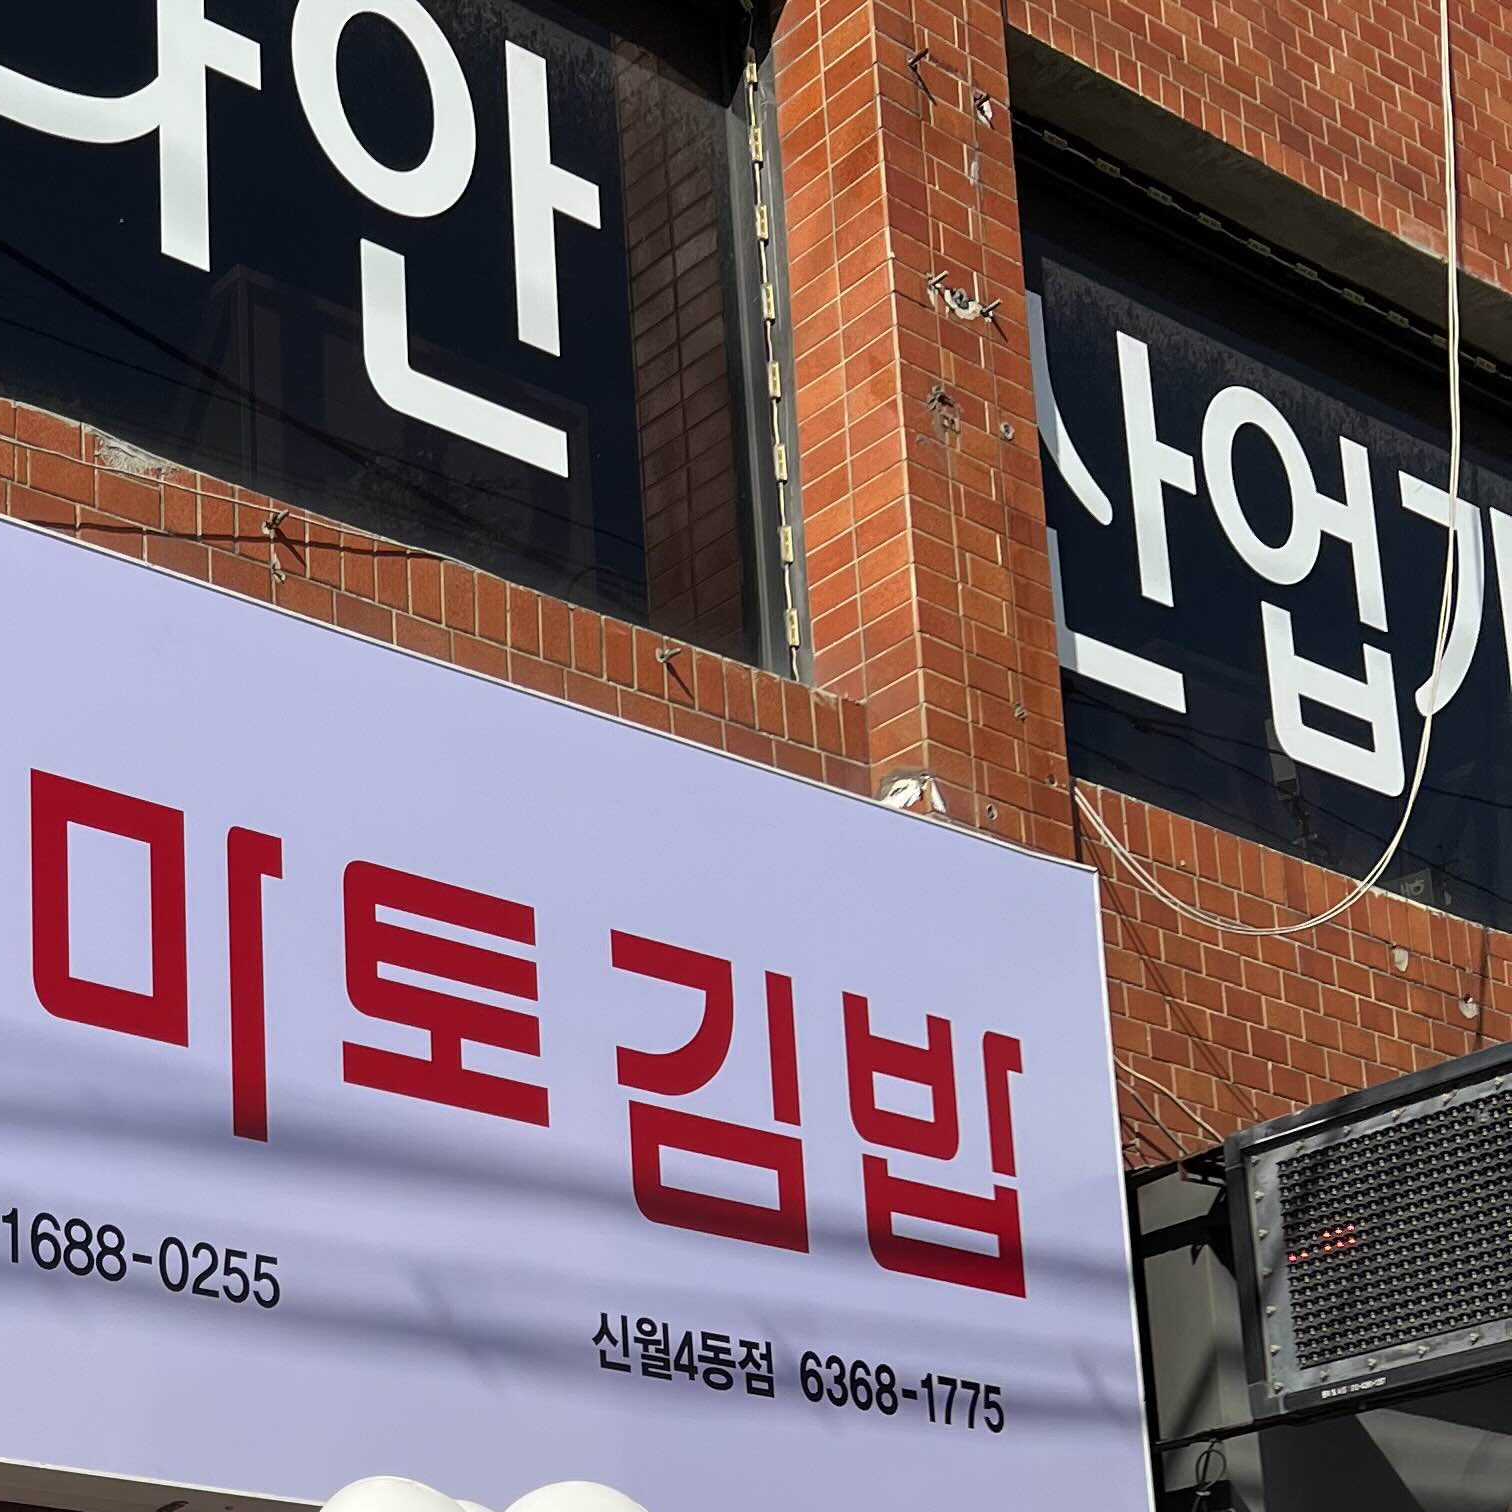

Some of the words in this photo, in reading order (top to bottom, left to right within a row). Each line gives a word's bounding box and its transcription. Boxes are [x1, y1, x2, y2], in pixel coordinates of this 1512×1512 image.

[1, 1207, 281, 1309] 1688-0255
[592, 1312, 776, 1398] 신월4동점
[799, 1350, 1005, 1434] 6368-1775
